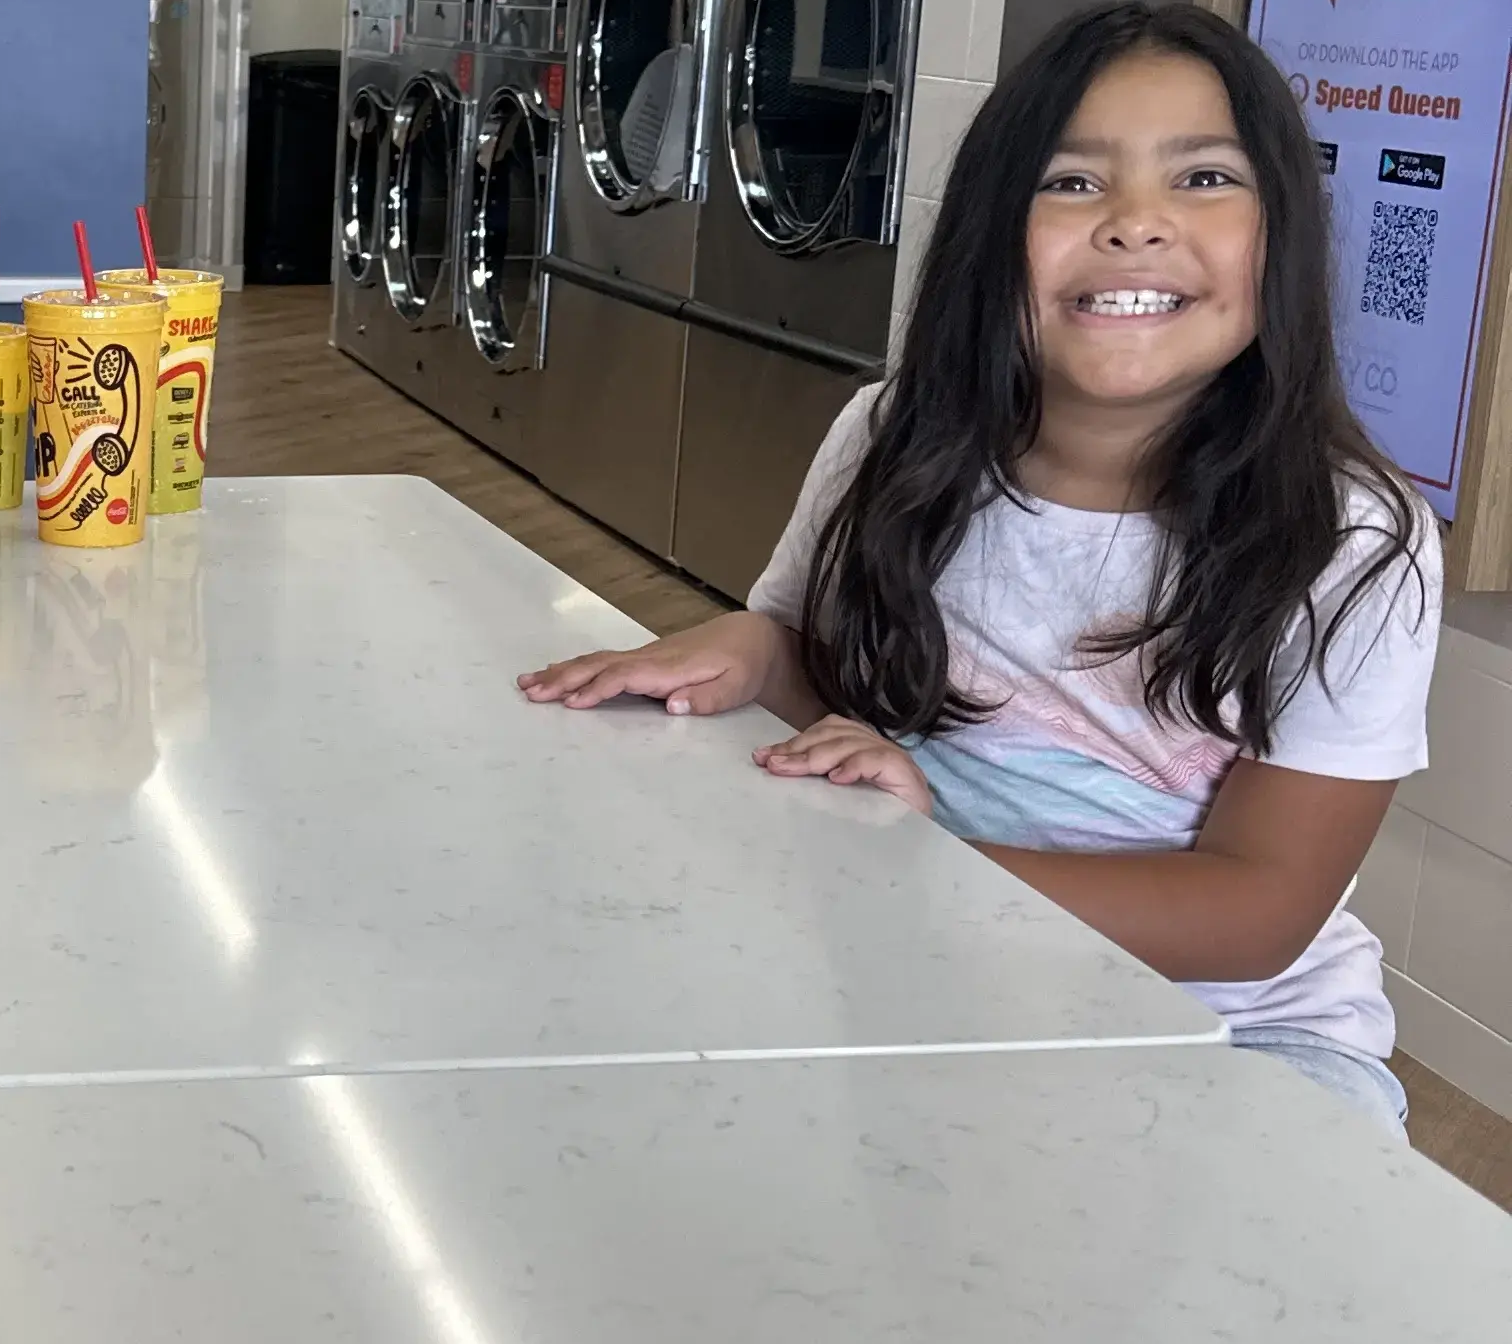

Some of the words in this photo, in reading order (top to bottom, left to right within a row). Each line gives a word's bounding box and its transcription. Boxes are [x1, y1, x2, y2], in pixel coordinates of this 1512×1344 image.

[1298, 42, 1317, 61] OR
[1319, 44, 1399, 69] DOWNLOAD
[1401, 49, 1429, 72] THE
[1430, 52, 1459, 73] APP
[1315, 78, 1383, 113] Speed
[1388, 85, 1462, 121] Queen
[1397, 164, 1423, 183] Google
[1423, 167, 1440, 186] Play
[168, 316, 214, 336] SHARE
[61, 386, 100, 402] CALL
